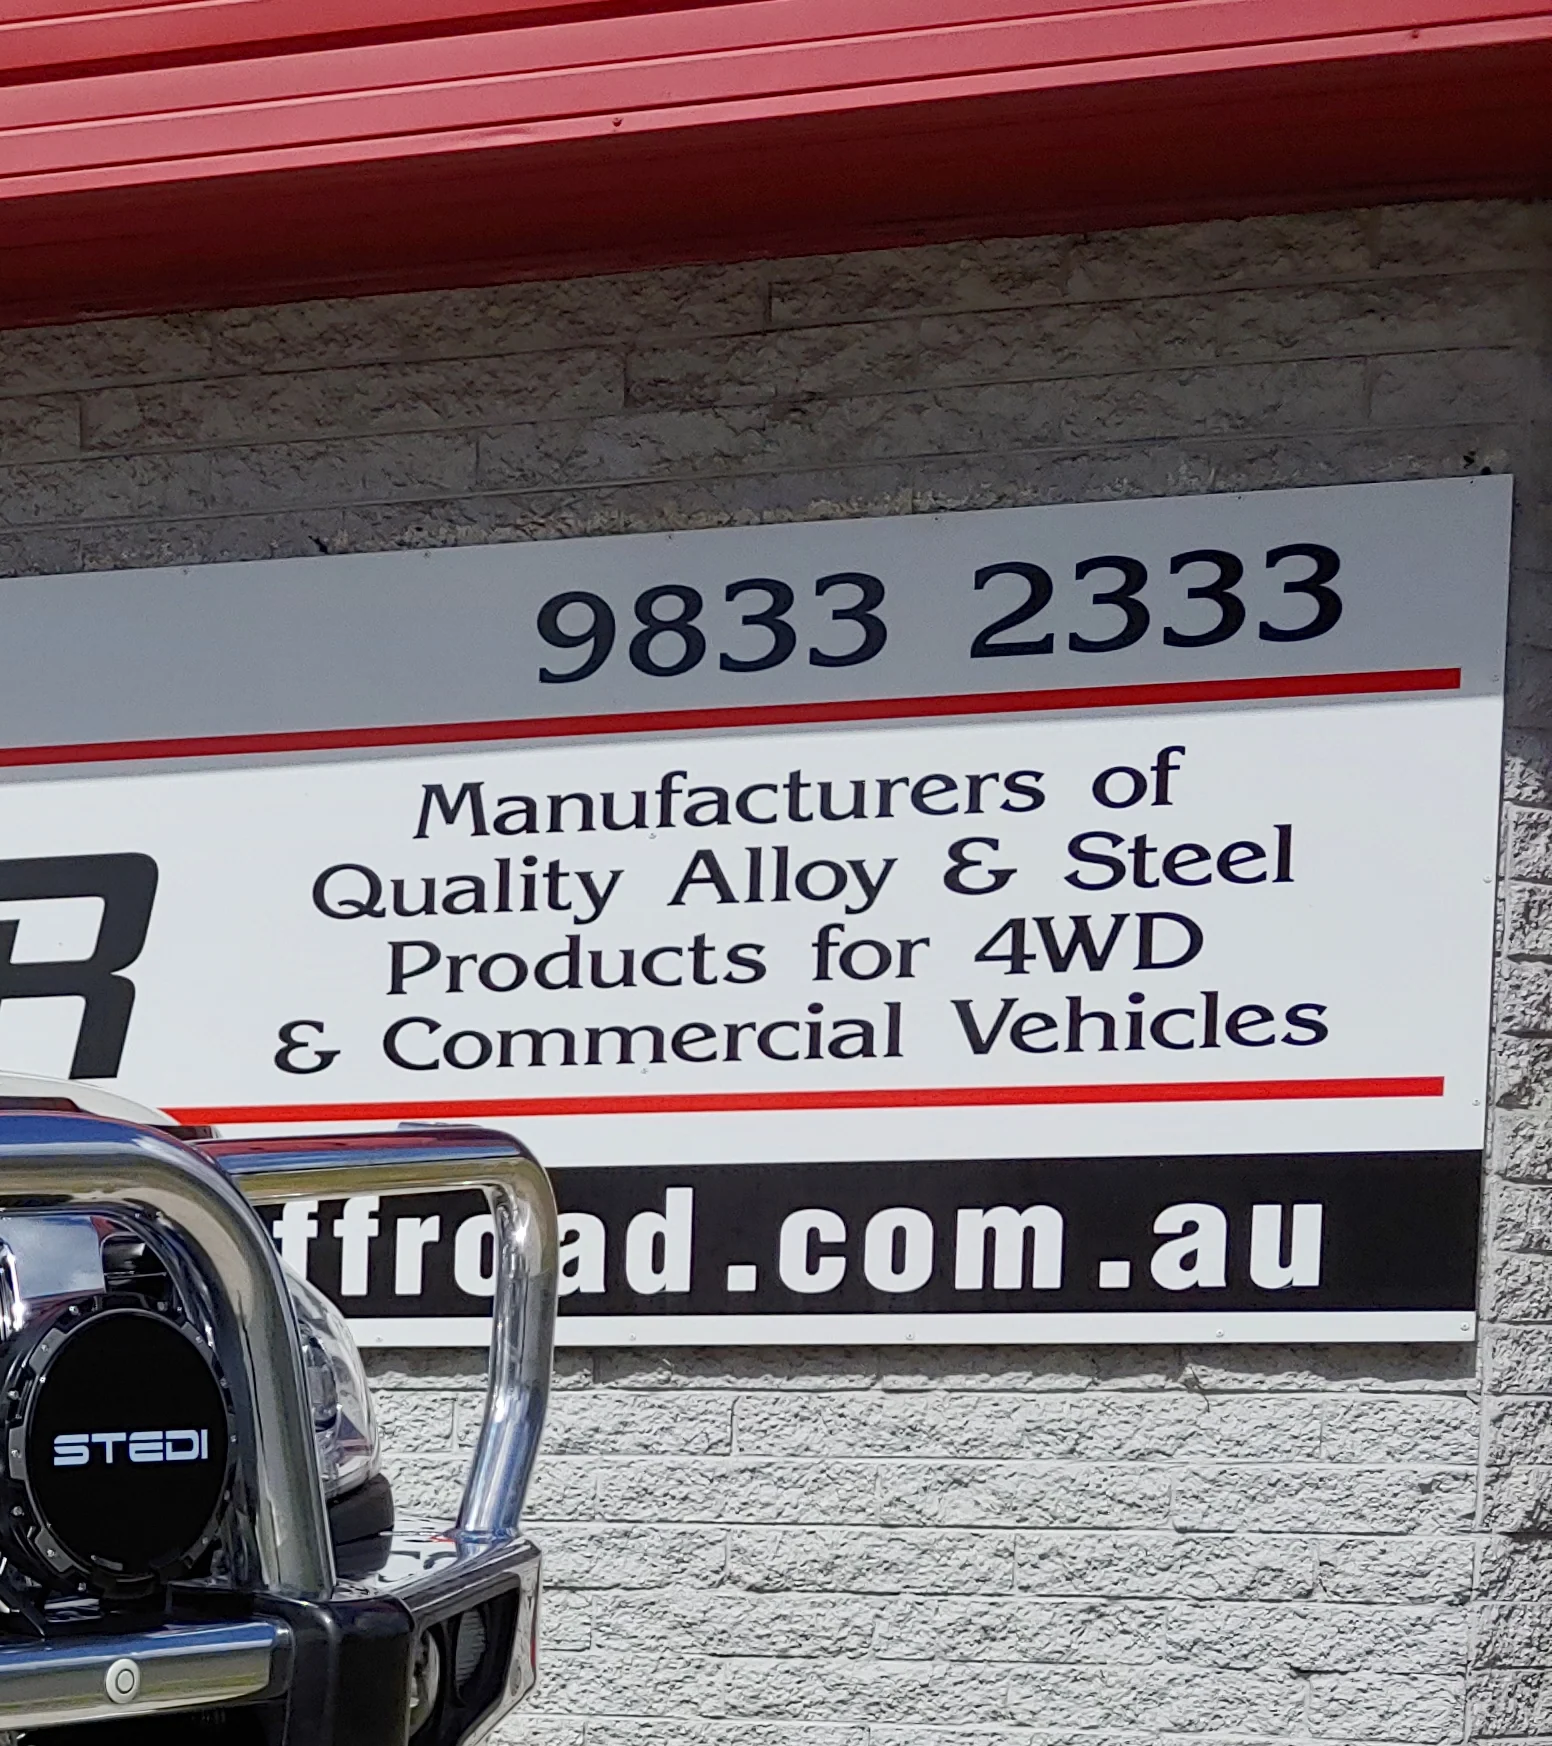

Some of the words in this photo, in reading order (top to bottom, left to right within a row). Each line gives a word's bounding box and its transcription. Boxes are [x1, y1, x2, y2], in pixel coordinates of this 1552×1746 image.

[535, 570, 889, 685] 9833
[969, 541, 1345, 660] 2333
[411, 769, 1047, 841] Manufacturers
[1091, 744, 1187, 810] of
[311, 855, 625, 926] Quality
[665, 845, 899, 916] Alloy
[942, 836, 1019, 897] &
[1063, 822, 1296, 892] Steel
[385, 932, 768, 997] Products
[810, 921, 931, 982] for
[973, 910, 1205, 976] 4WD
[273, 1019, 342, 1076] &
[381, 1000, 905, 1072] Commercial
[949, 989, 1330, 1056] Vehicles
[52, 1428, 211, 1468] STEDI
